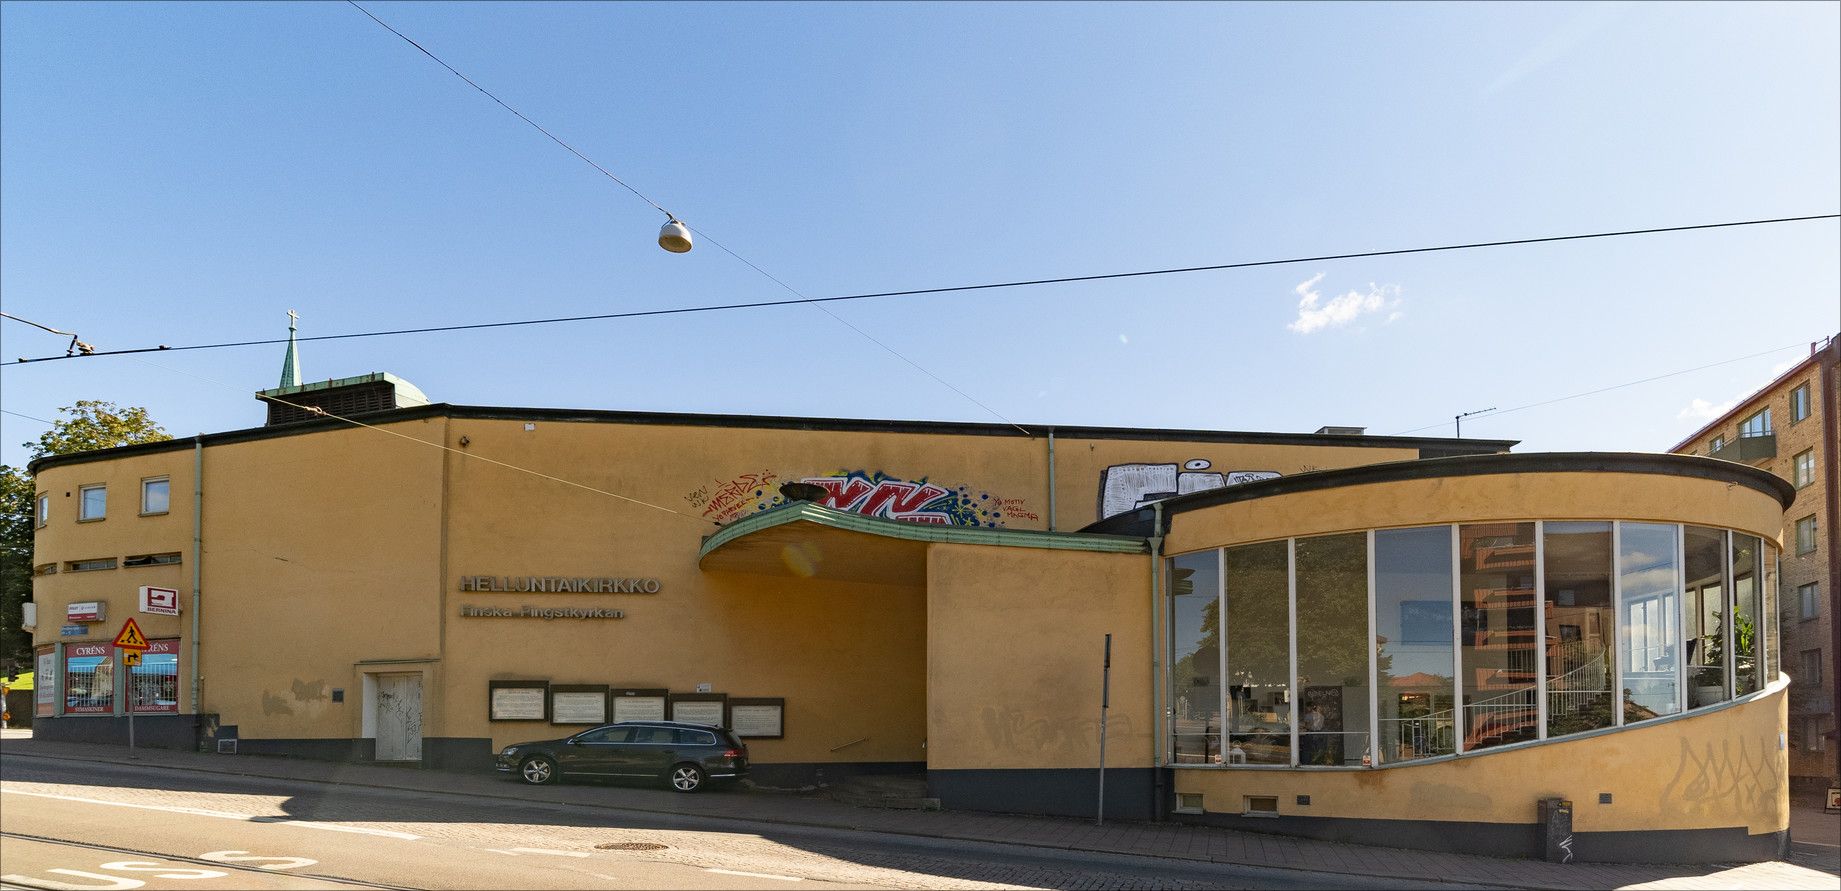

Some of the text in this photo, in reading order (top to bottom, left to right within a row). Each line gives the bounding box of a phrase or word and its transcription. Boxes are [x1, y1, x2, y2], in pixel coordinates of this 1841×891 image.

[460, 576, 661, 594] HELLUNTAIKIRKKO
[147, 607, 176, 615] BERNINA
[460, 604, 513, 618] Finska
[76, 646, 106, 656] CYRÉNS
